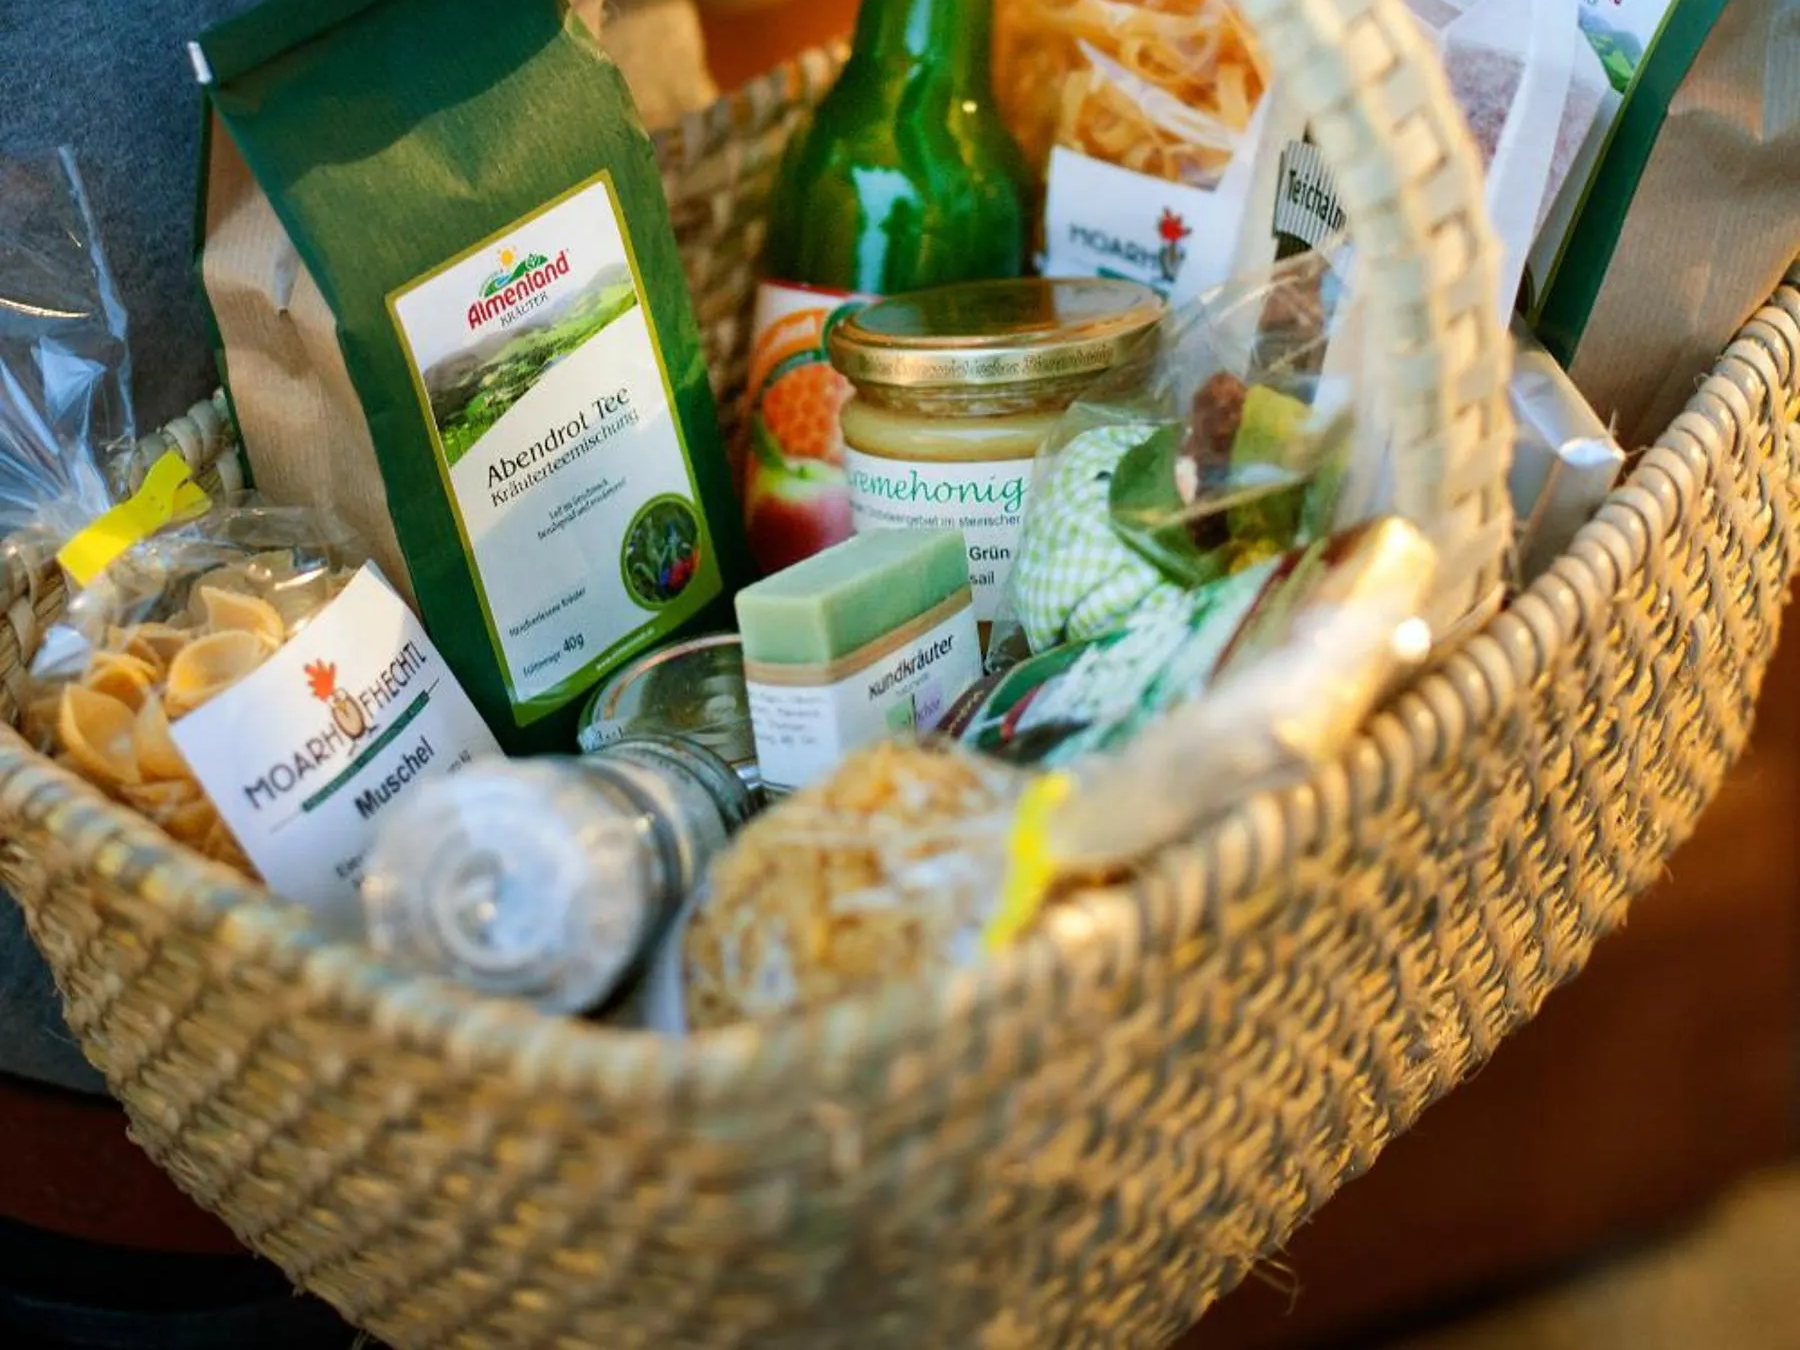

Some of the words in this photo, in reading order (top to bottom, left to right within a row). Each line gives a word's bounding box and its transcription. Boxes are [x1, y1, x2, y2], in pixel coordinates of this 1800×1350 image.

[467, 250, 570, 330] Almenland
[488, 411, 588, 488] Abendrot
[592, 387, 630, 420] Tee
[490, 408, 639, 507] Kräuterteemischung
[849, 469, 1026, 512] remehonig
[969, 545, 1010, 561] Grün
[563, 633, 585, 653] 40g
[244, 639, 427, 810] MOARHOFHECHTL
[354, 735, 435, 820] Muschel
